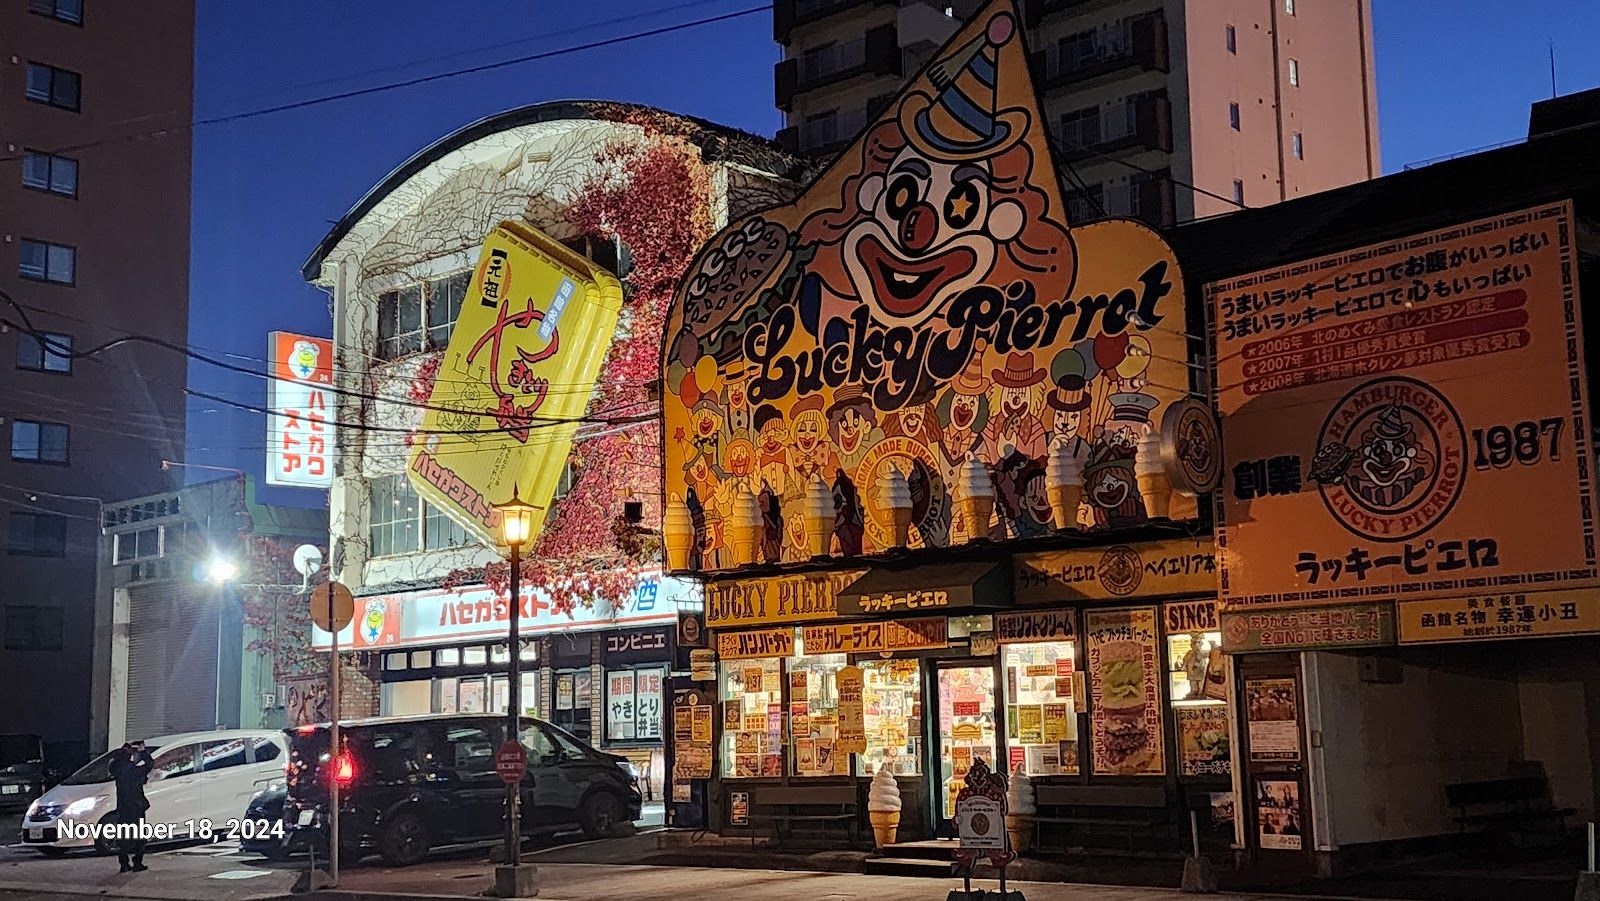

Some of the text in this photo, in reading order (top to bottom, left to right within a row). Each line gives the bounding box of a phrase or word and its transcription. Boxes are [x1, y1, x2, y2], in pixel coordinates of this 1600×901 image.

[484, 259, 502, 298] 元祖
[1221, 232, 1549, 319] うまいラッキーピエロでお腹がいっぱい
[1223, 263, 1533, 341] うまいラッキーピエロで心もいっぱい
[743, 260, 1172, 410] Lucky Pierrot
[320, 374, 328, 382] 24
[1330, 385, 1449, 438] HAMBURGER
[282, 408, 301, 473] ストア
[307, 391, 325, 475] ハセガワ
[856, 439, 940, 490] HOME MADE BURGER
[1231, 416, 1565, 500] 創業 1987
[1331, 446, 1459, 533] LUCKY PIERROT
[1019, 565, 1096, 588] ラッキーピエロ
[1295, 538, 1500, 584] ラッキーピエロ
[708, 580, 769, 621] LUCKY
[859, 590, 948, 612] ラッキーピエロ
[1169, 602, 1217, 631] SINCE
[1497, 601, 1578, 623] 幸運小丑
[385, 633, 395, 643] 24
[607, 633, 665, 651] コンビニエ
[738, 631, 791, 655] ハンバーガー
[824, 624, 882, 650] カレーライス
[611, 698, 659, 719] やきとり
[638, 717, 659, 736] 弁当
